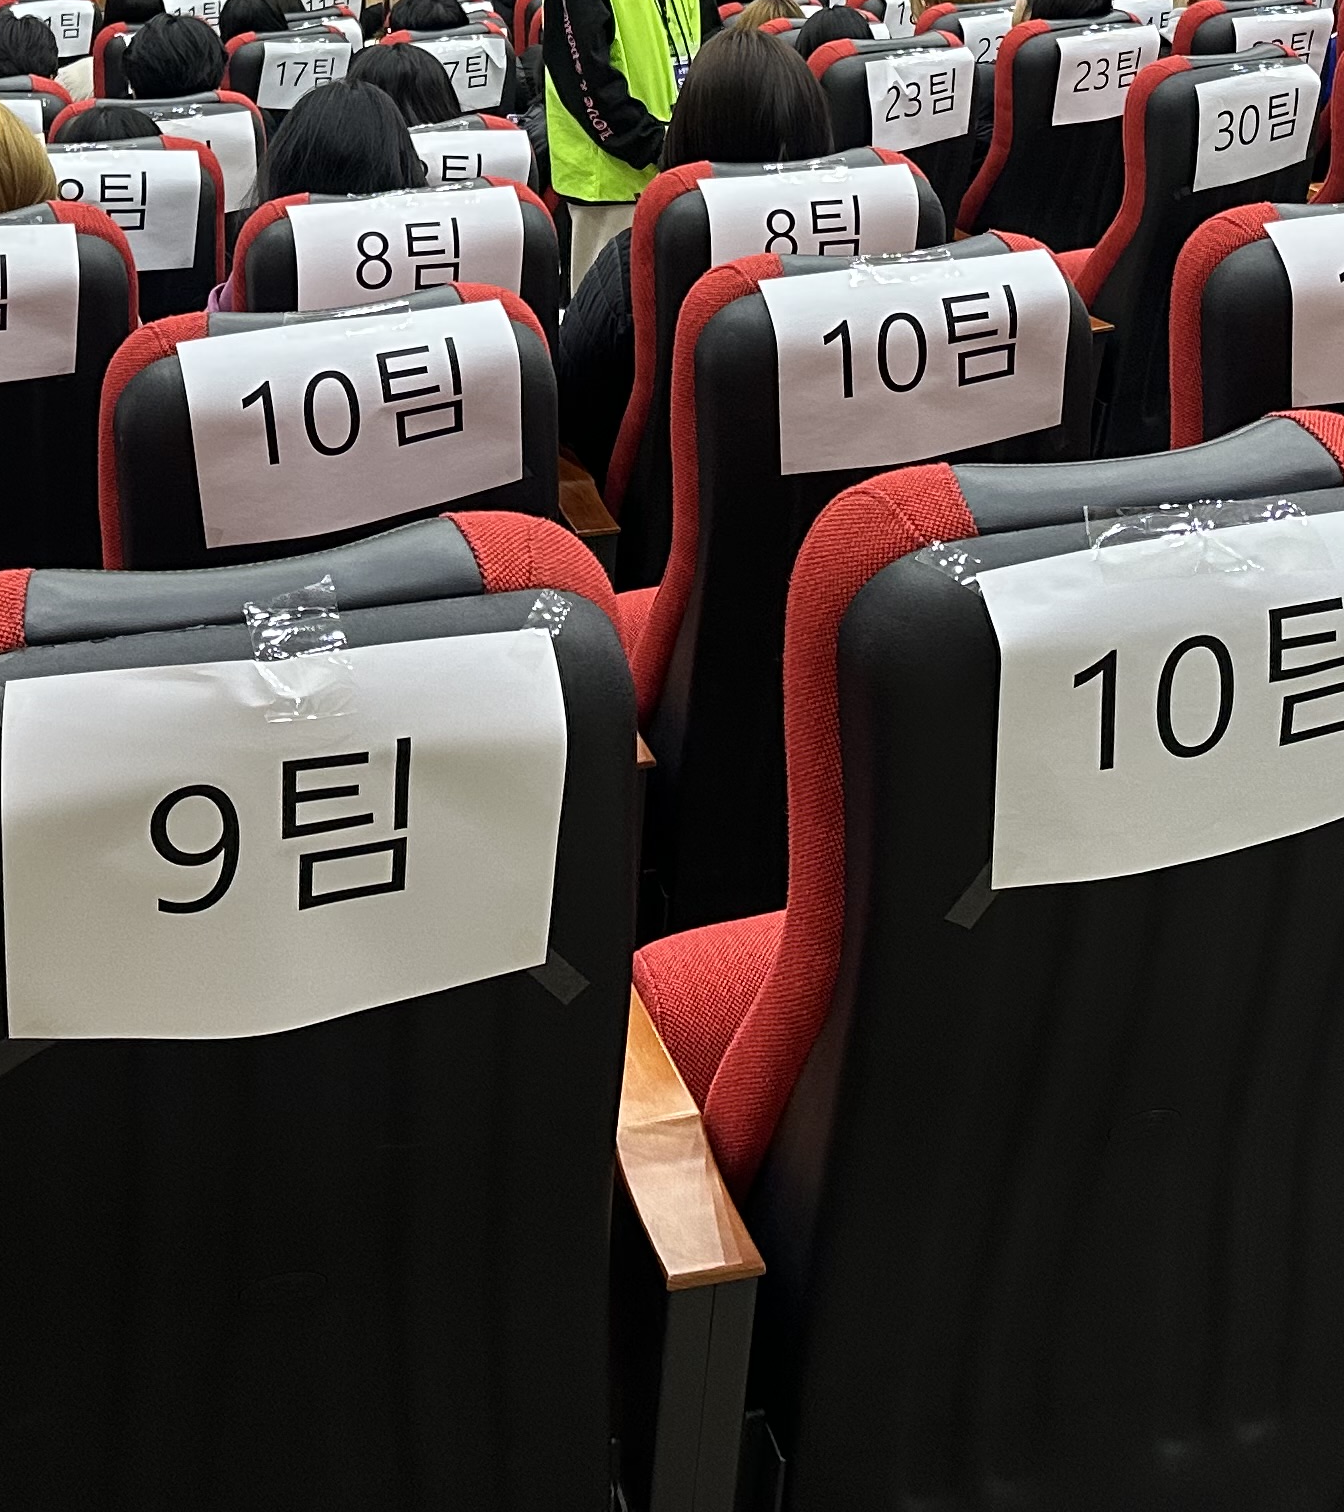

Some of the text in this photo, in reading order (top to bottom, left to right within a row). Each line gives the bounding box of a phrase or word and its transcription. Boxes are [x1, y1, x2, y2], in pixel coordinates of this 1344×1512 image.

[275, 56, 336, 87] 17팀
[442, 53, 490, 90] 7팀
[885, 67, 956, 123] 23팀
[1073, 47, 1142, 93] 23팀
[1214, 87, 1299, 152] 30팀
[355, 217, 462, 290] 8팀
[764, 193, 864, 257] 8팀
[822, 284, 1018, 399] 10팀
[241, 336, 464, 466] 10팀
[150, 736, 412, 914] 9팀
